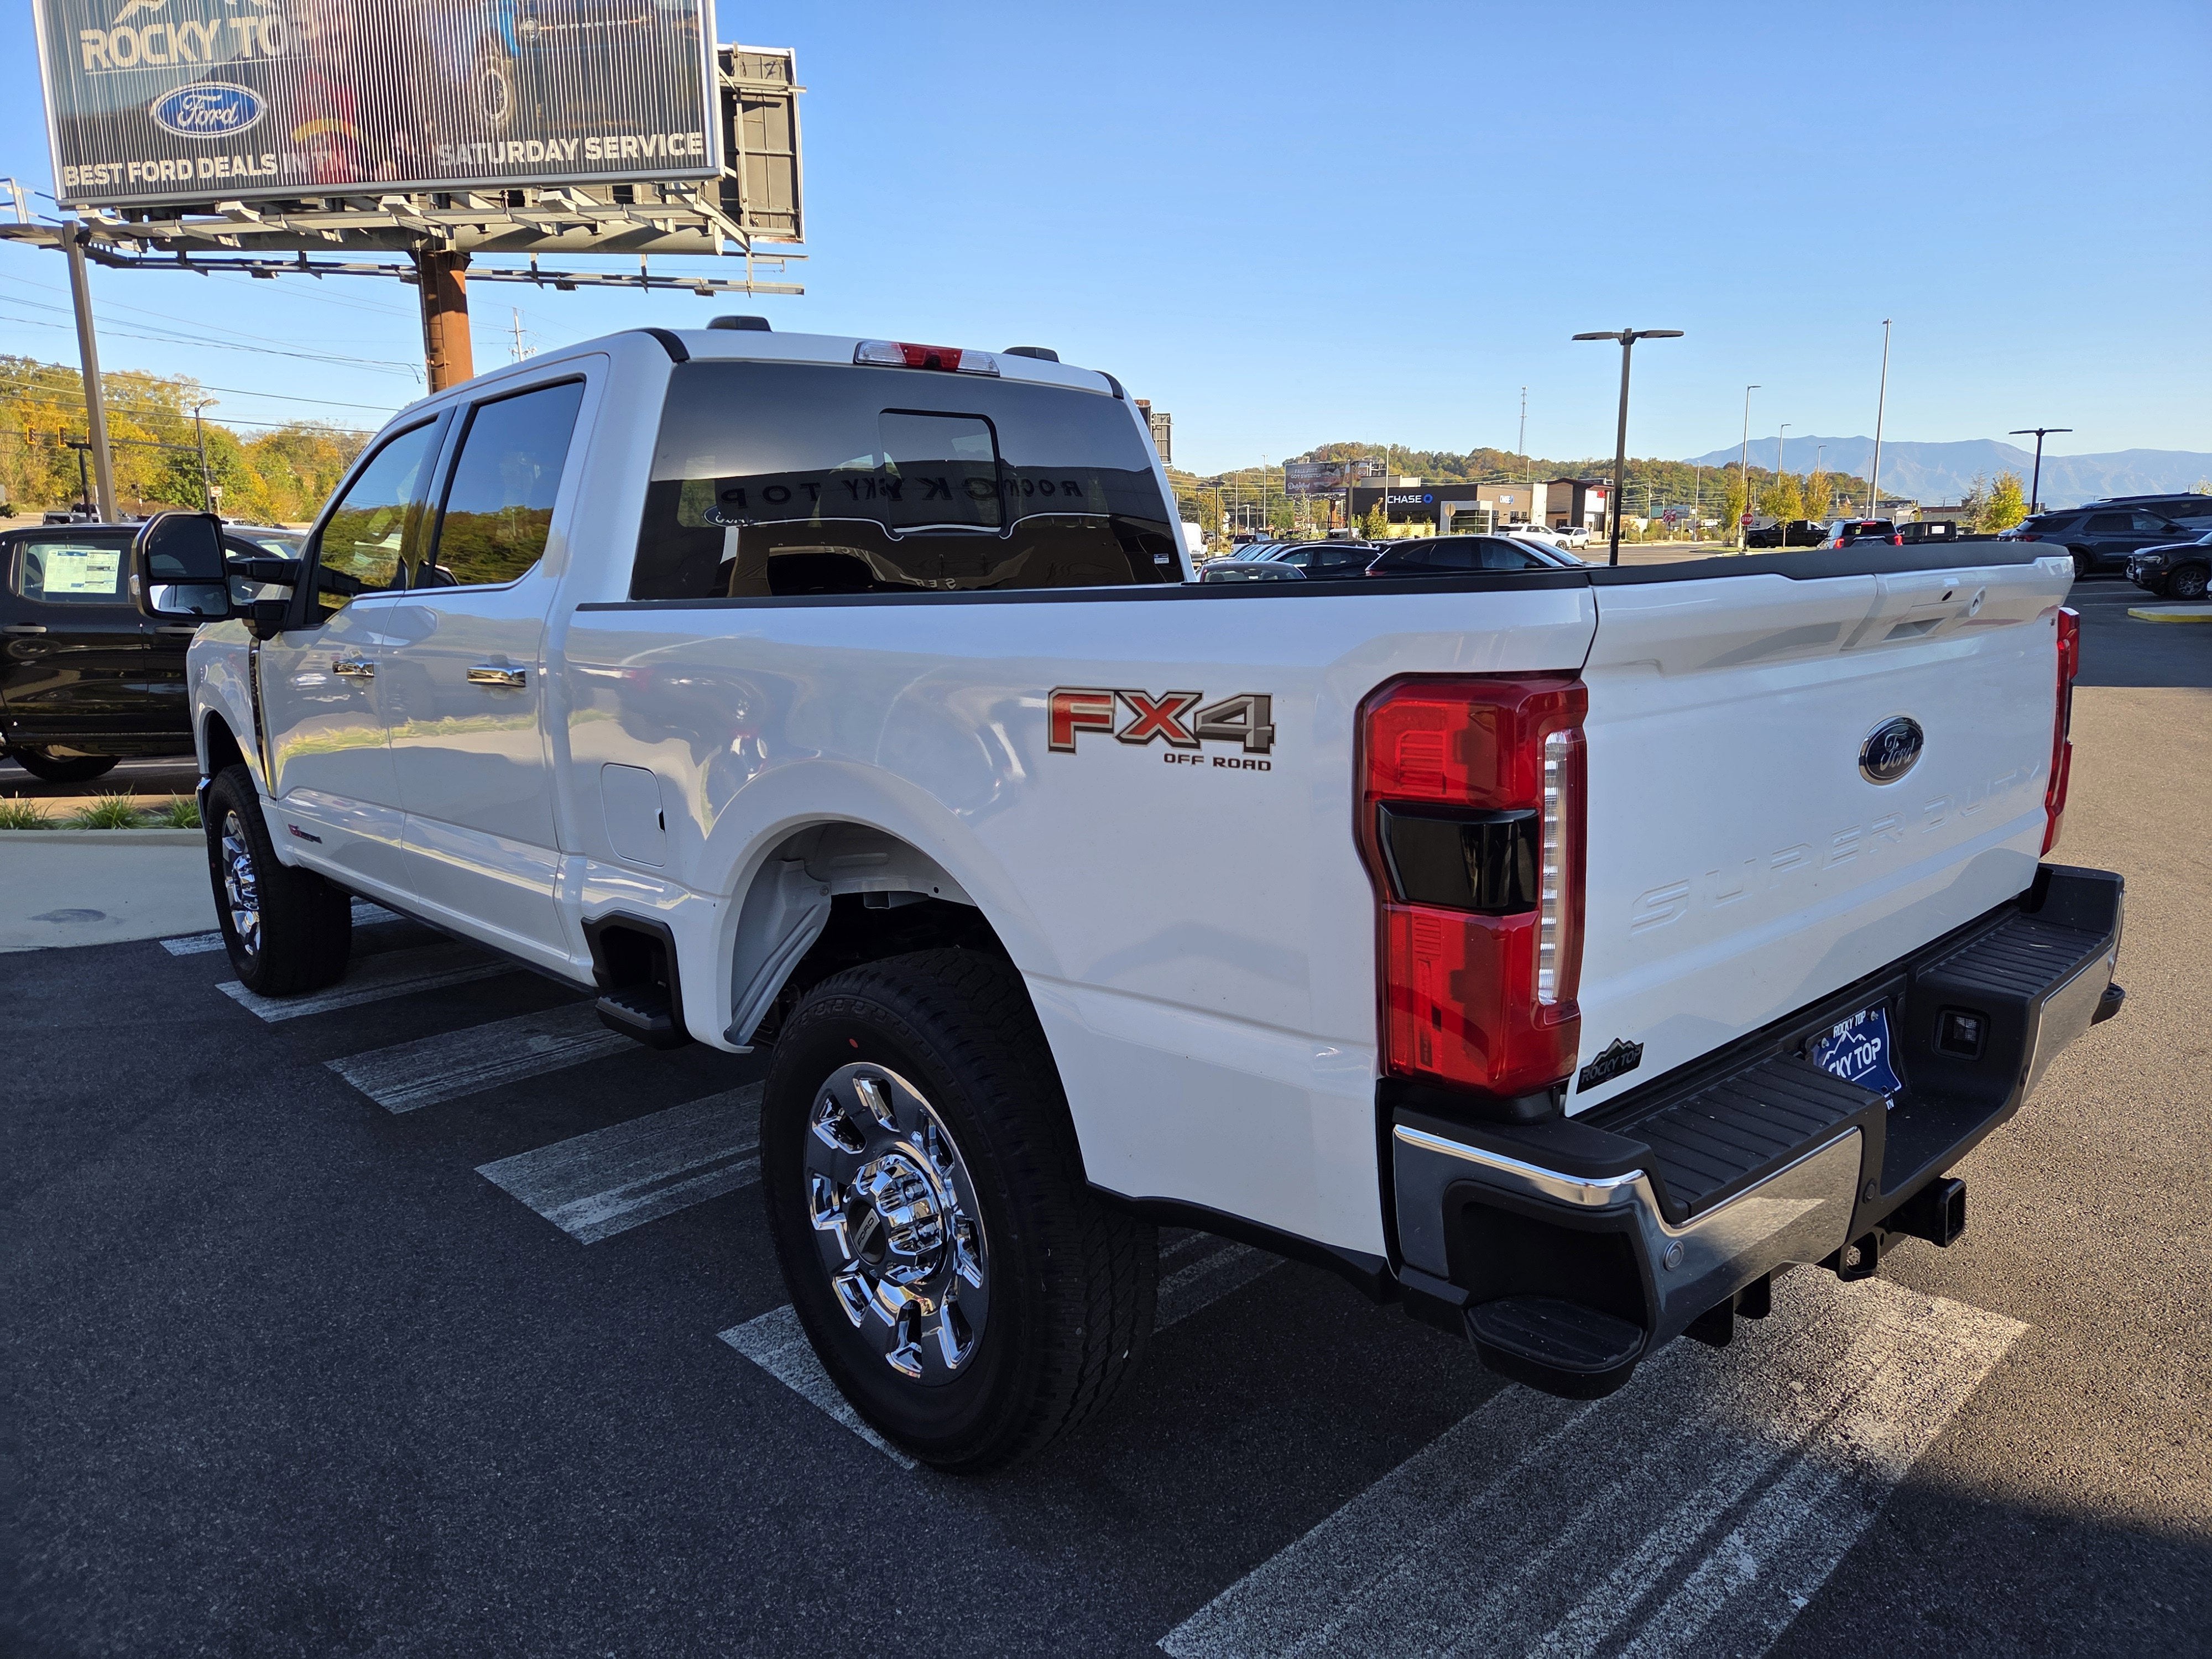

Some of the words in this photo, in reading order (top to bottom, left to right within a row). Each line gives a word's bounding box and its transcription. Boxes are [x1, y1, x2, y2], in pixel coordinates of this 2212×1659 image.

[80, 19, 221, 70] ROCKY
[229, 13, 320, 57] TOP
[177, 93, 239, 127] Ford
[437, 138, 579, 166] SATURDAY
[585, 132, 704, 161] SERVICE
[64, 163, 123, 186] BEST
[128, 158, 193, 184] FORD
[197, 153, 278, 179] DEALS
[1387, 495, 1422, 504] CHASE
[1047, 685, 1276, 757] FX4
[1164, 753, 1204, 767] OFF
[1212, 757, 1271, 772] ROAD
[1880, 731, 1916, 771] Ford
[1631, 811, 1906, 936] SUPER
[1922, 761, 2041, 834] DUTY
[1833, 1017, 1854, 1039] ROCKY
[1855, 1010, 1866, 1027] TOP
[1582, 1056, 1620, 1083] ROCKY
[1621, 1047, 1642, 1067] TOP
[1854, 1037, 1881, 1070] TOP
[857, 1217, 874, 1247] FORD
